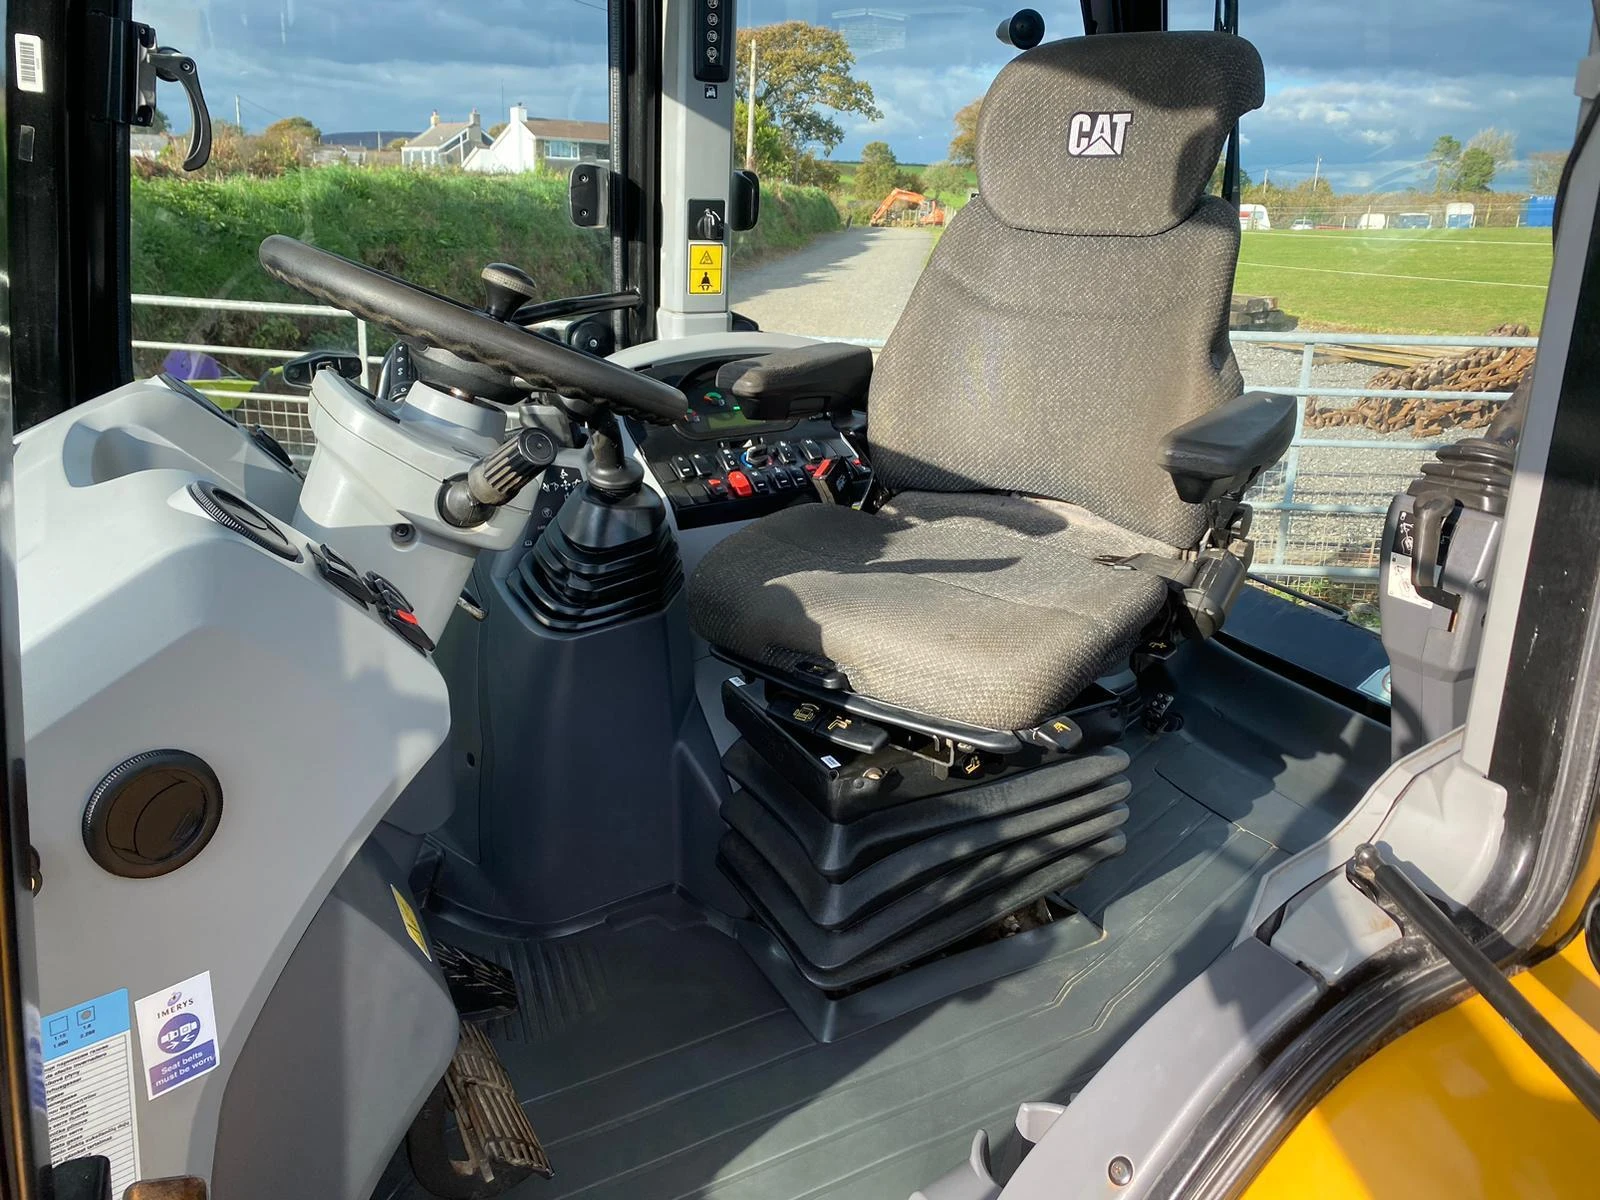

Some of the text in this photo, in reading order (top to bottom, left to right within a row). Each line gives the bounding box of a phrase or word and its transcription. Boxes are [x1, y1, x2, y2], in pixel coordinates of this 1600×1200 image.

[1068, 113, 1132, 156] CAT
[157, 998, 194, 1019] IMERYS
[155, 1054, 214, 1087] must be worn
[161, 1051, 203, 1075] Seat belts
